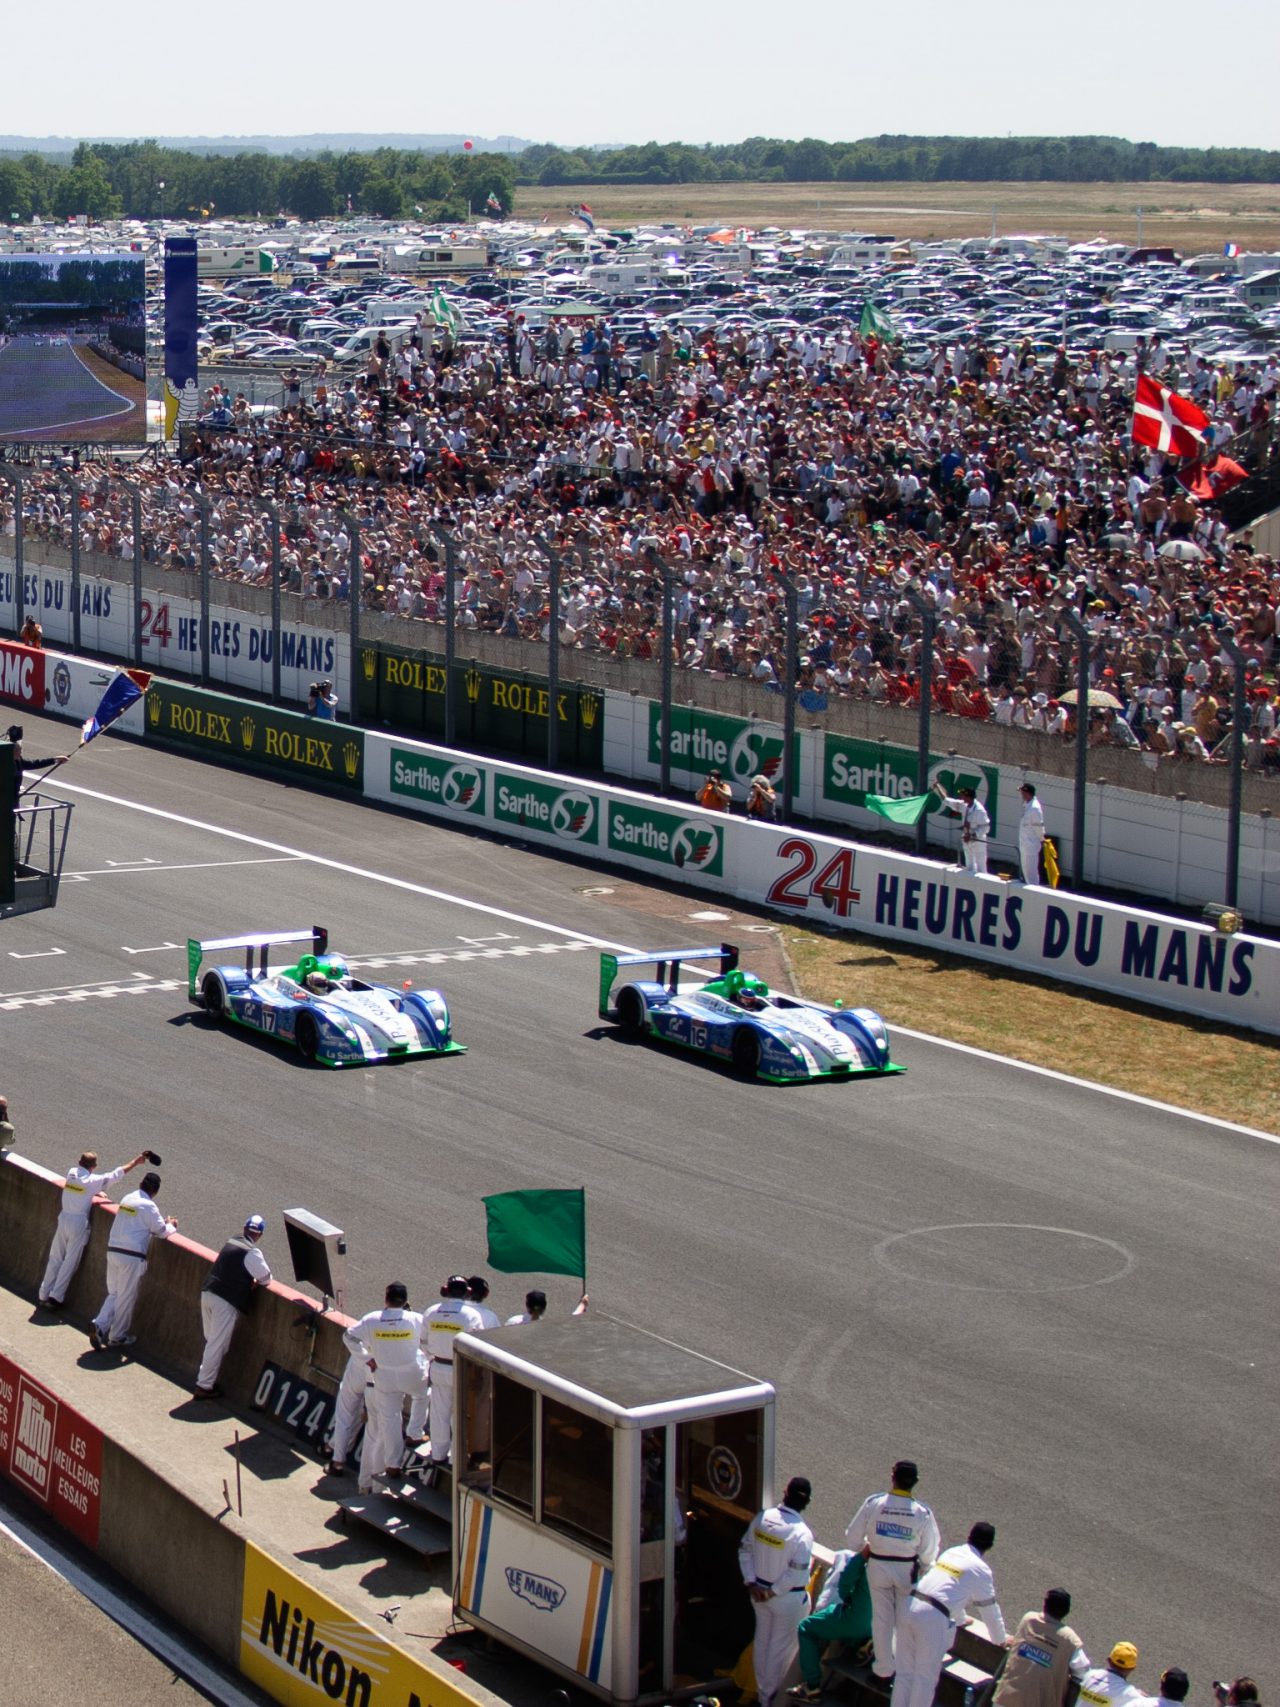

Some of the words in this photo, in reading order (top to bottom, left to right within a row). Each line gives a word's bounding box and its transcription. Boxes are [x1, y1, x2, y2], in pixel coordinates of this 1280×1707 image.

[44, 578, 64, 610] DU
[132, 598, 172, 648] 24
[178, 617, 241, 658] HERES
[248, 628, 273, 664] DU
[281, 631, 335, 674] MANS
[170, 703, 232, 744] ROLEX
[264, 727, 334, 770] ROLEX
[394, 760, 440, 793] Sarthe
[831, 753, 914, 799] Sarthe
[498, 786, 549, 822] Sarthe
[613, 814, 669, 852] Sarthe
[766, 836, 862, 918] 24
[875, 872, 1024, 952] HEURES
[1042, 904, 1104, 968] DU
[1121, 920, 1256, 998] MANS
[263, 1012, 276, 1033] 17
[692, 1026, 707, 1048] 16
[326, 1050, 336, 1058] La
[70, 1432, 86, 1460] LES
[15, 1446, 46, 1487] moto
[53, 1447, 100, 1496] MEILLEURS
[58, 1477, 88, 1514] ESSAIS
[510, 1569, 522, 1586] LE
[524, 1576, 559, 1605] MANS
[260, 1588, 372, 1707] Nikon
